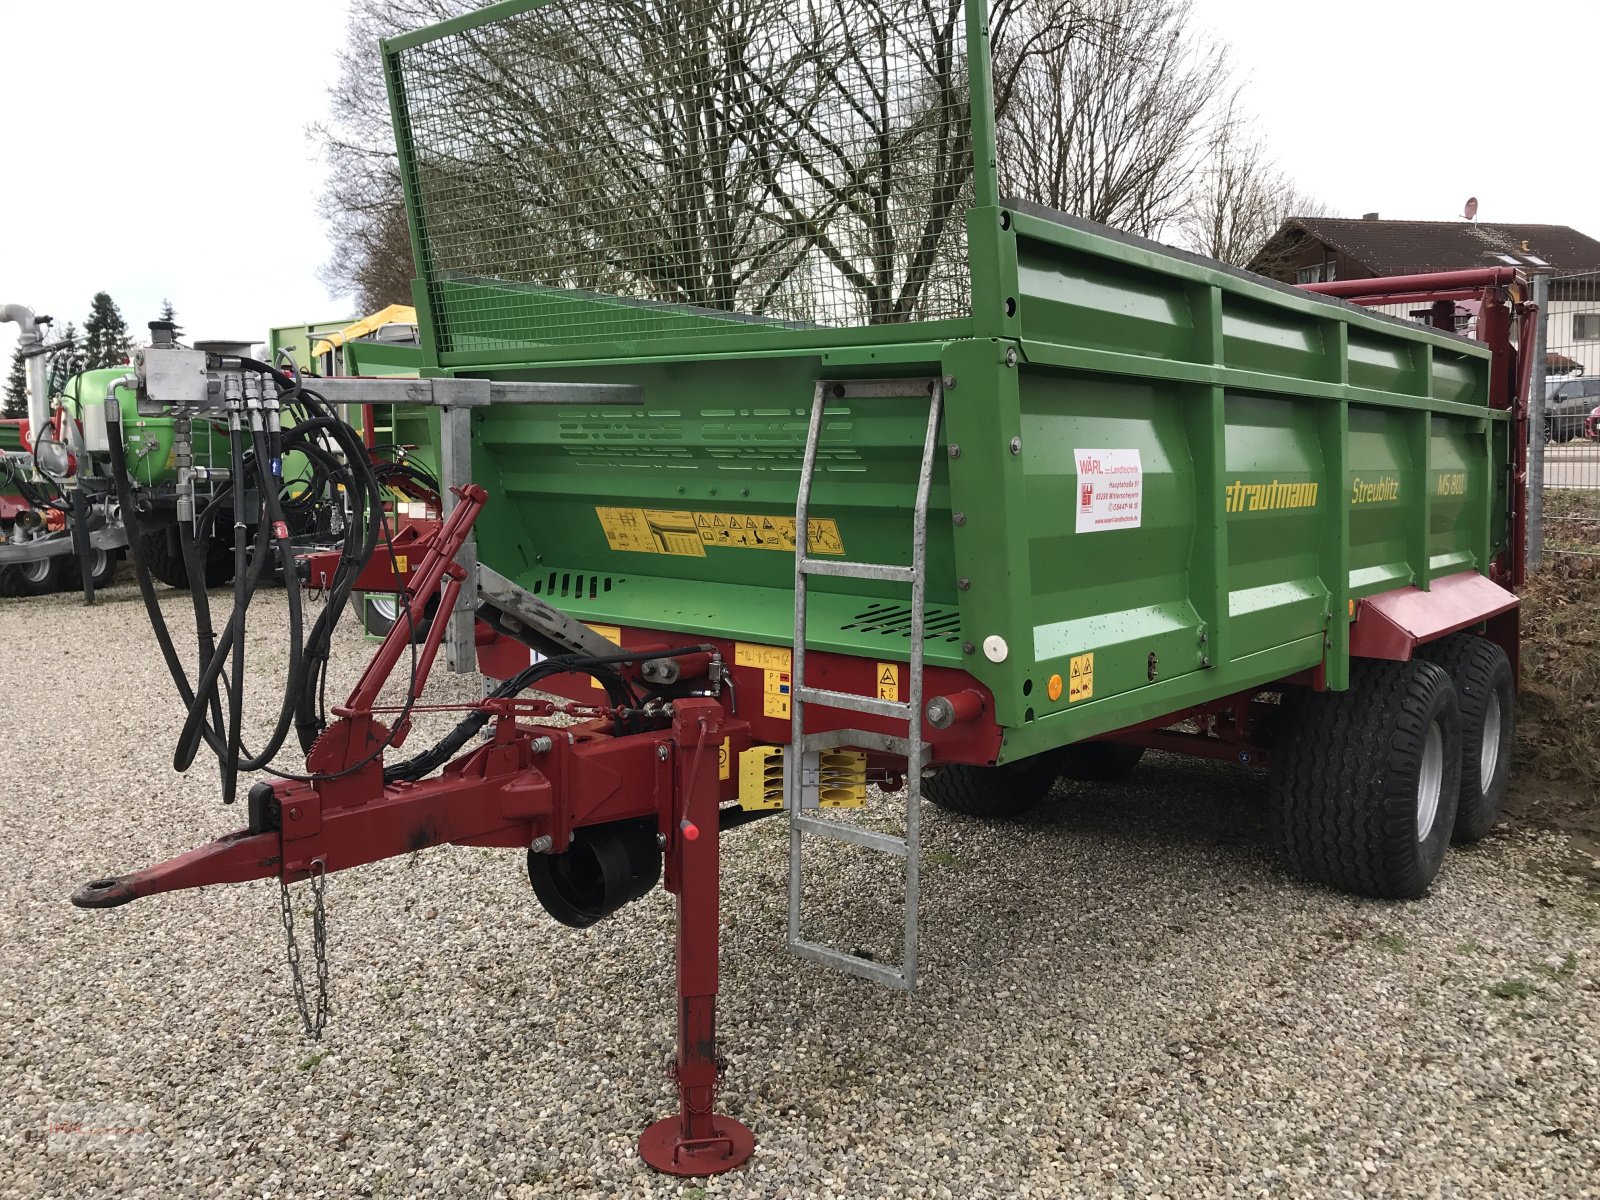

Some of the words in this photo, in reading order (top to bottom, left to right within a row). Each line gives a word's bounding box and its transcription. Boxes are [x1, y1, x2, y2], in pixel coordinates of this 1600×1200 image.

[1080, 456, 1103, 474] WÄRL
[1351, 476, 1399, 504] Streublitz
[1438, 473, 1450, 497] MS
